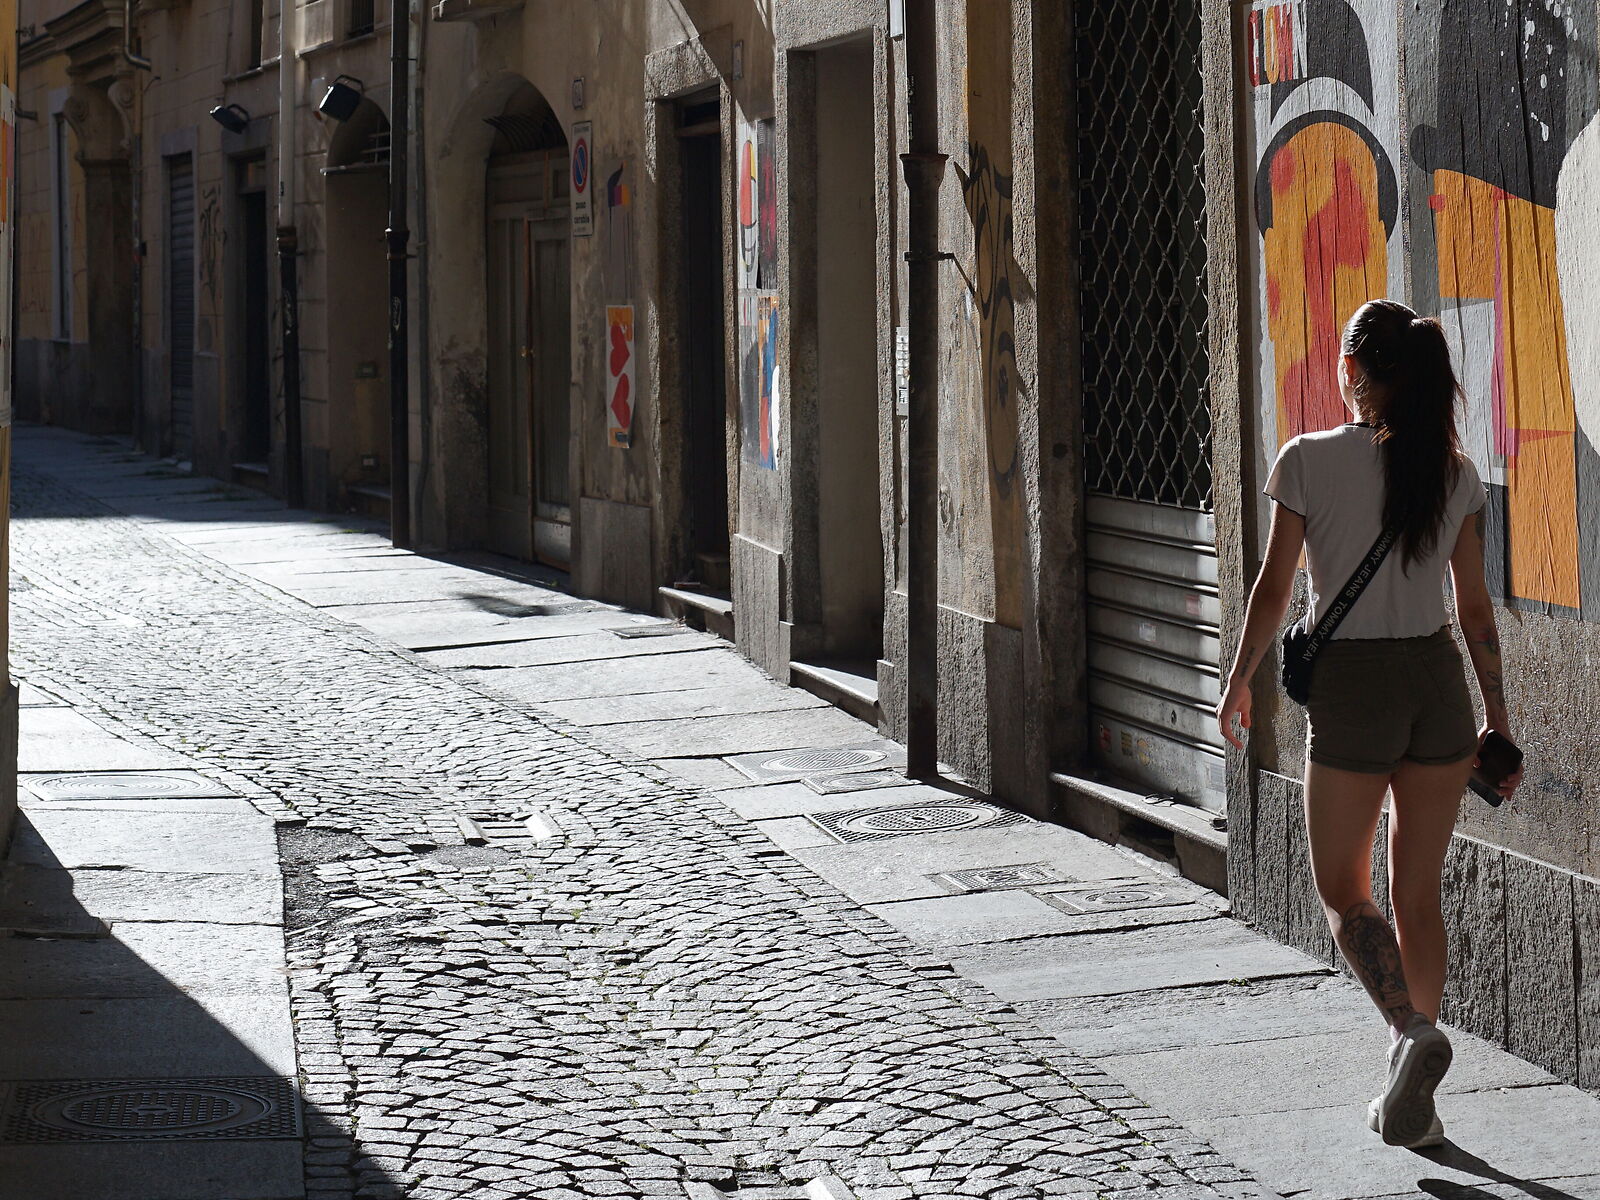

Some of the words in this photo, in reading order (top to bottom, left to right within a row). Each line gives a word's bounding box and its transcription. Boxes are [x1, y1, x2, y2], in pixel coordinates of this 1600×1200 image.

[1248, 1, 1308, 88] CLOWN
[1370, 531, 1393, 565] OMMY
[1345, 563, 1372, 598] JEANS
[1318, 601, 1348, 640] TOMMY
